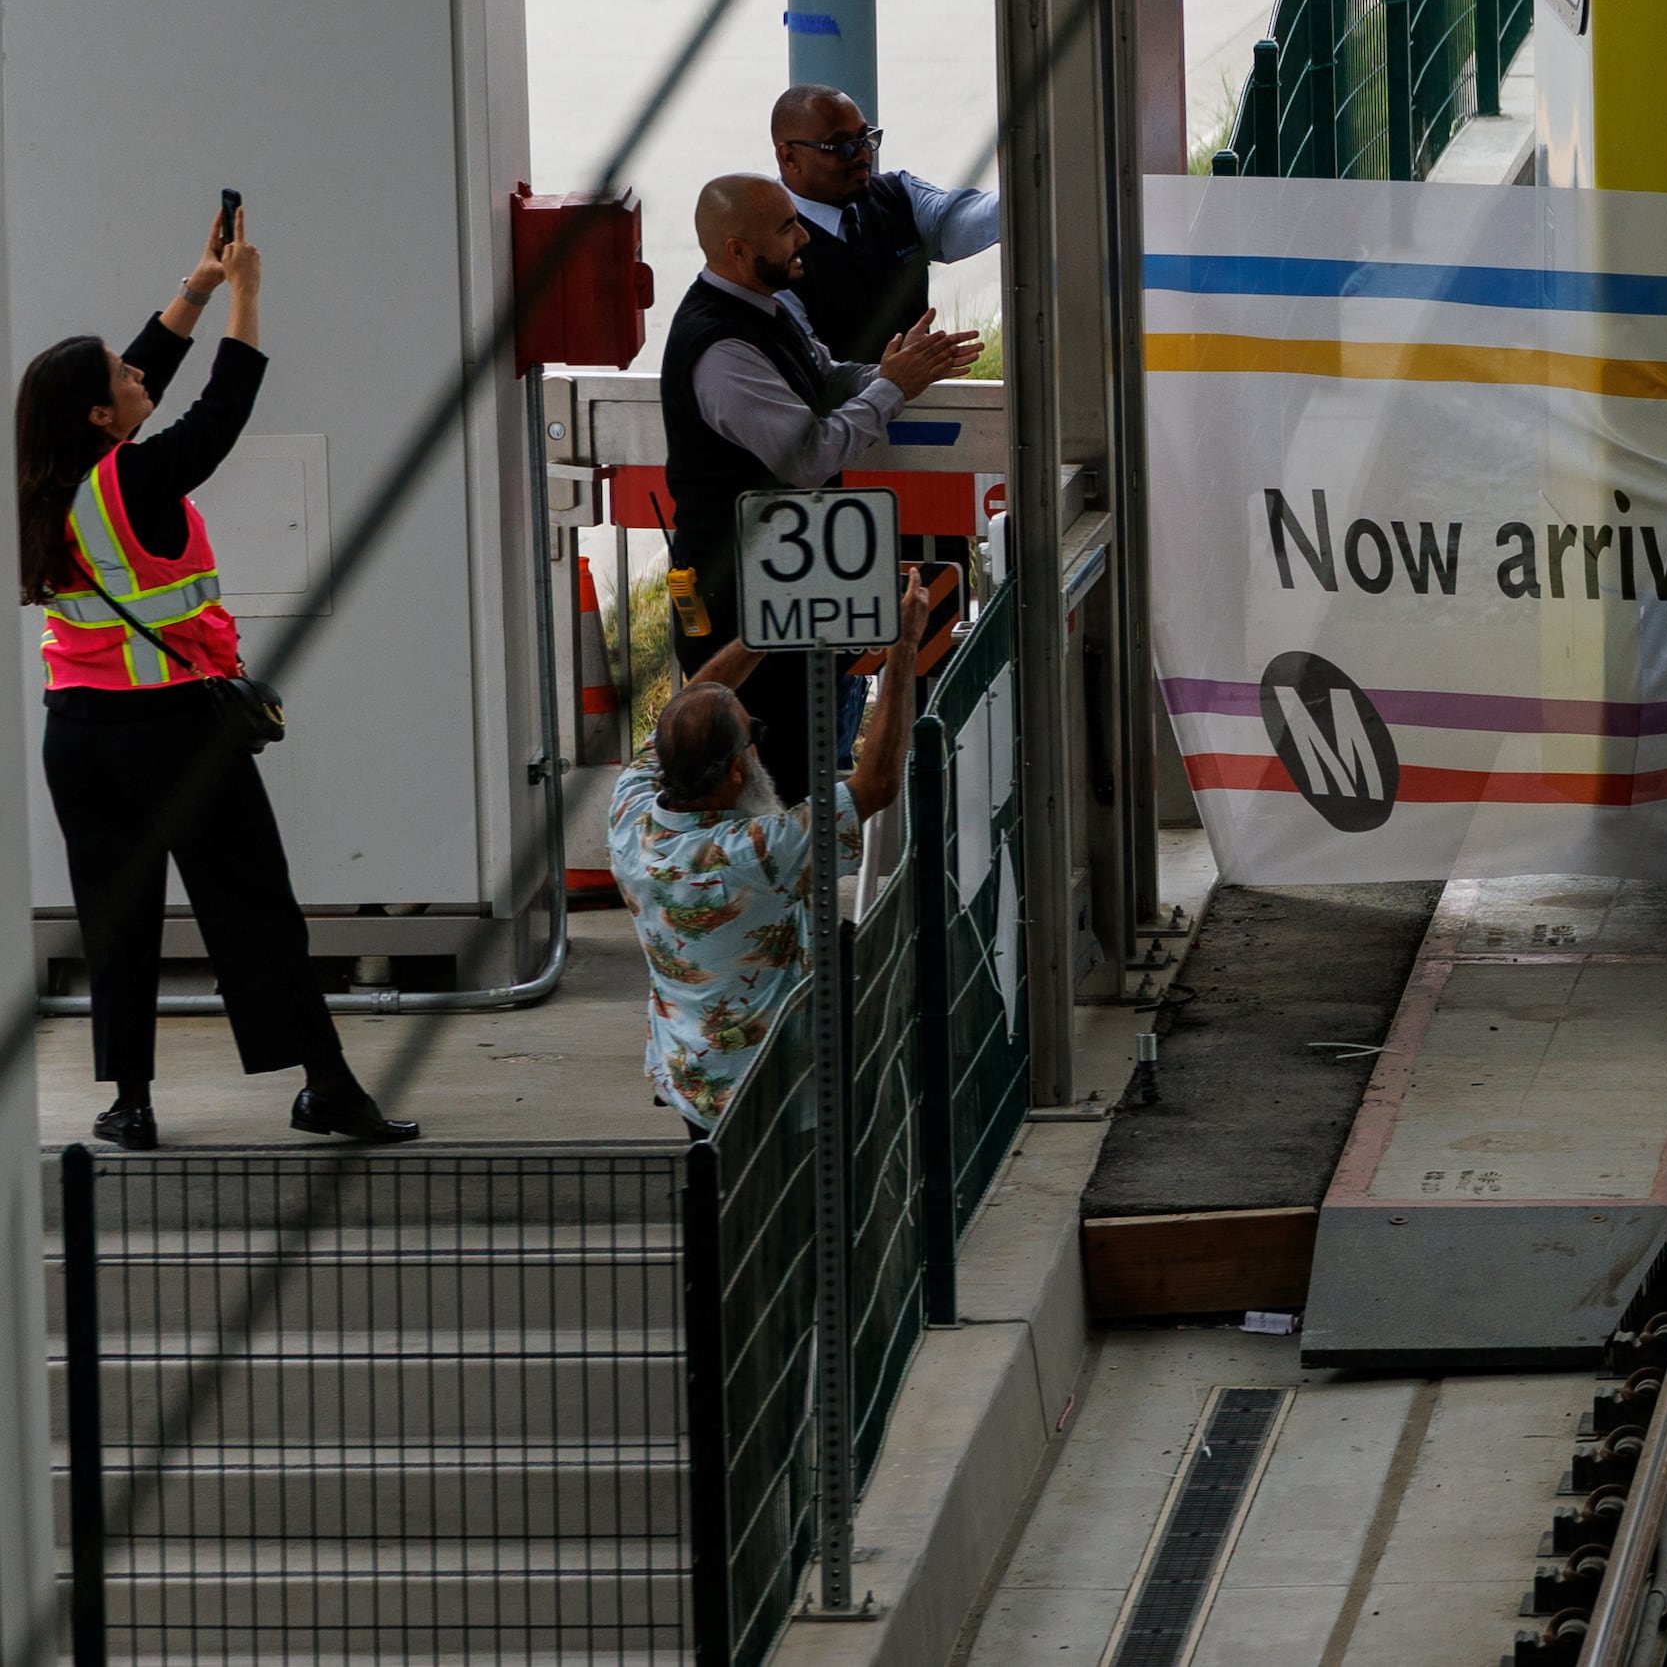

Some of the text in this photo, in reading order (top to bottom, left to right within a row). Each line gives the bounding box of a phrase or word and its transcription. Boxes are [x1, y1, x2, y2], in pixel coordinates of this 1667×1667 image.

[758, 497, 876, 583] 30
[1264, 487, 1460, 597] Now
[761, 596, 881, 641] MPH
[1273, 686, 1386, 800] M
